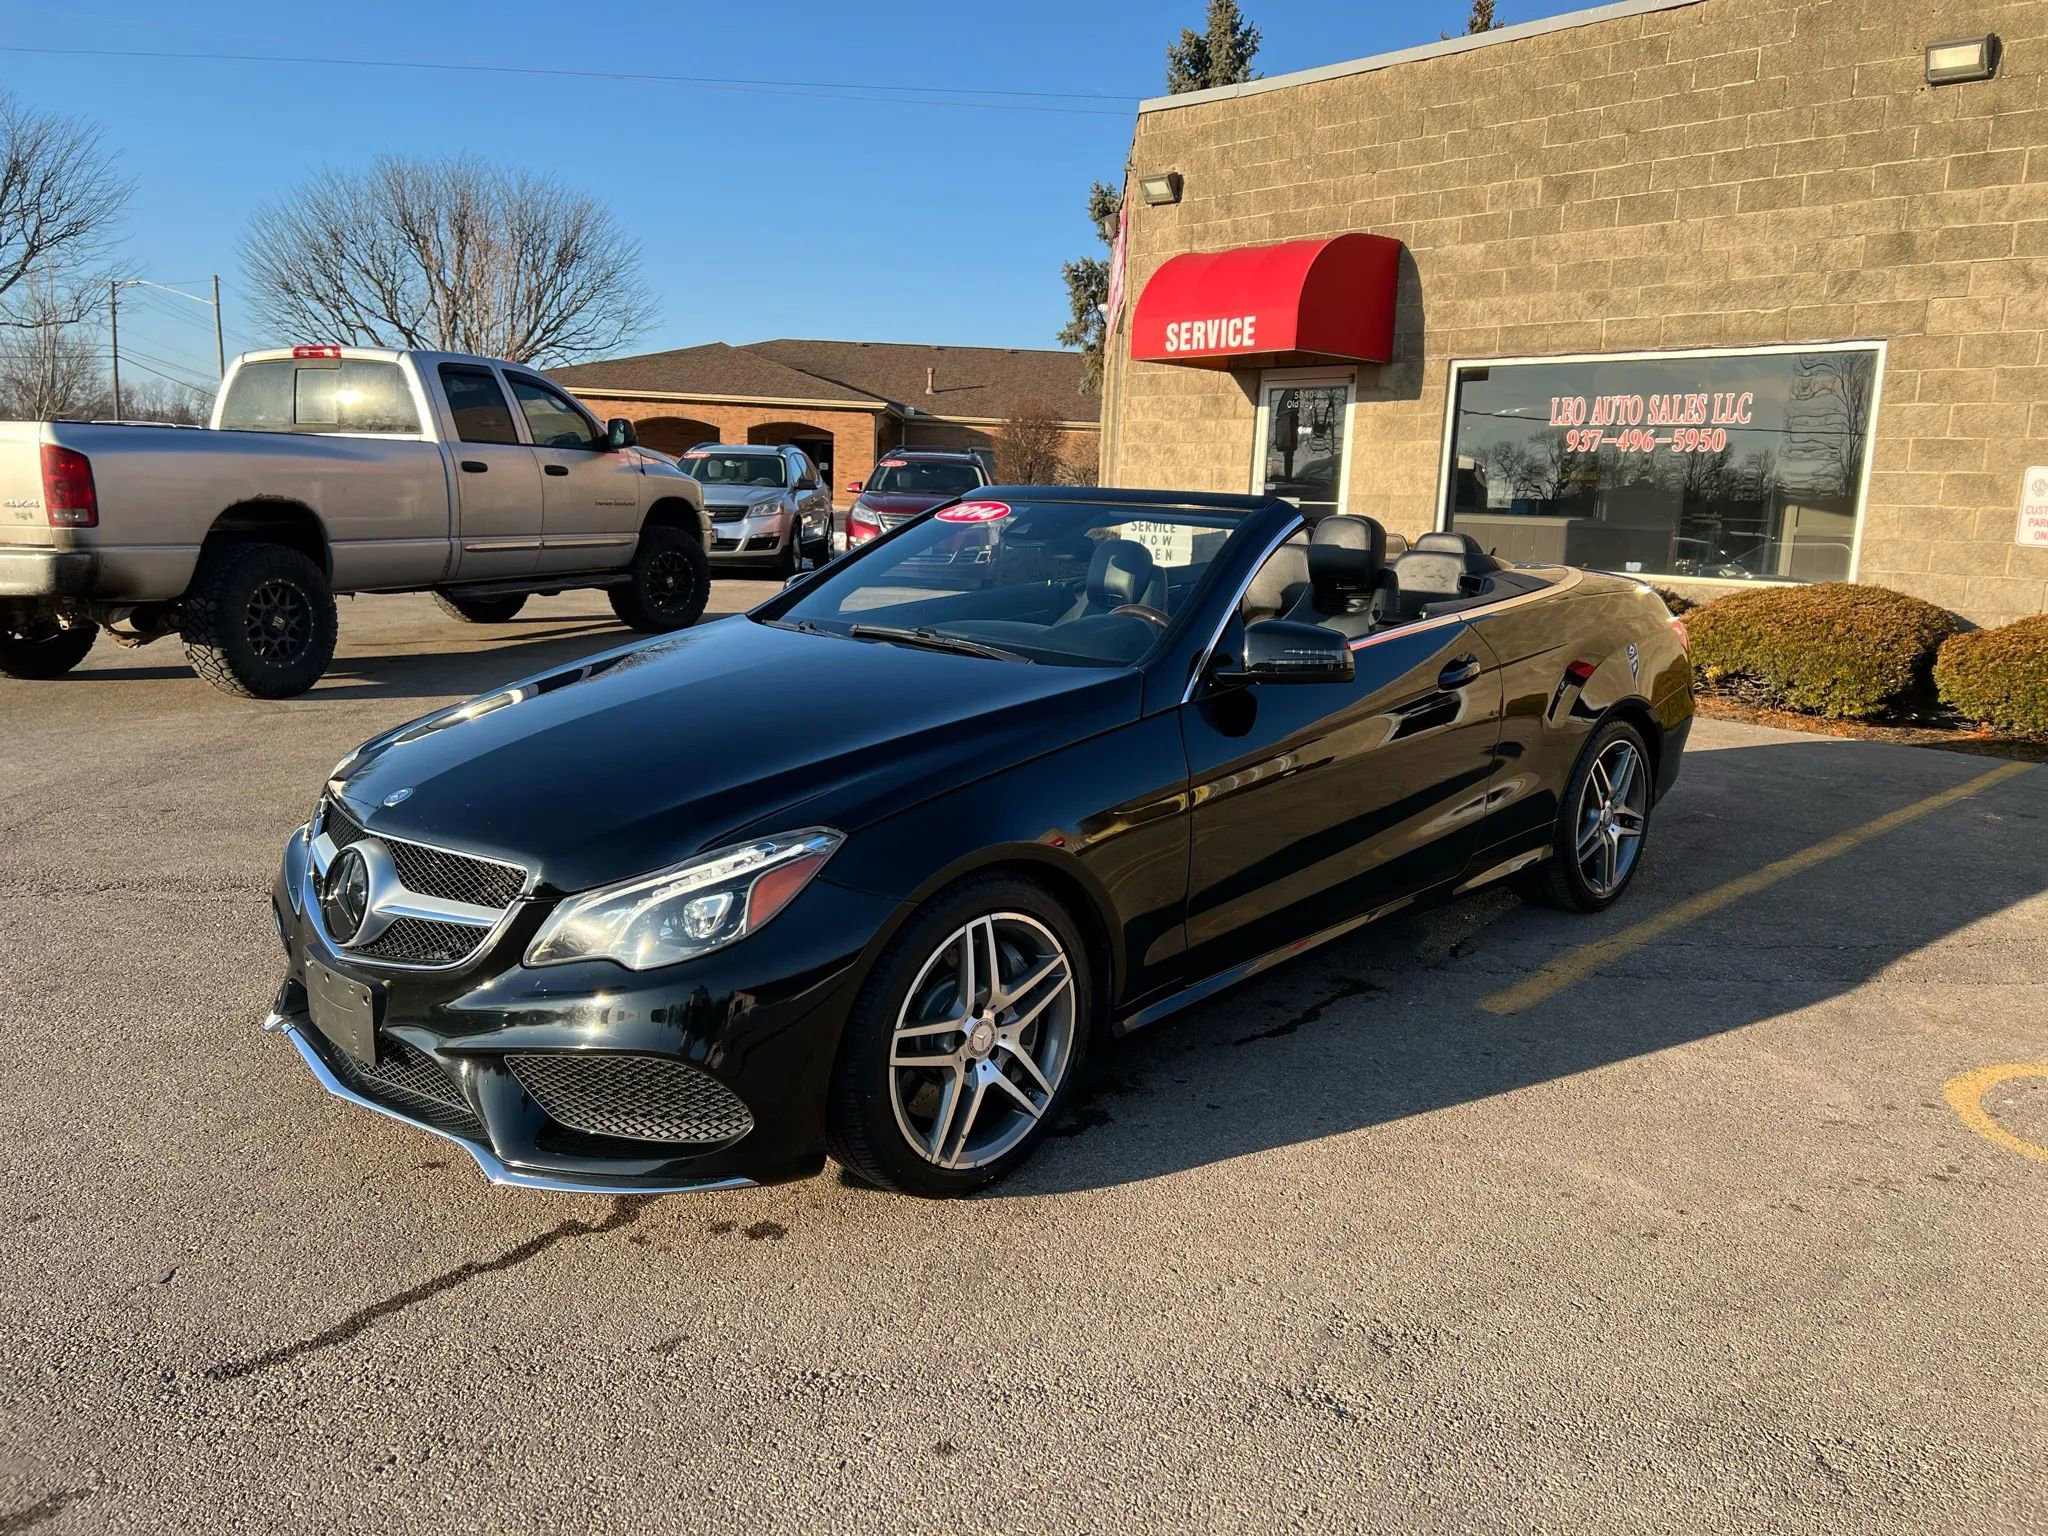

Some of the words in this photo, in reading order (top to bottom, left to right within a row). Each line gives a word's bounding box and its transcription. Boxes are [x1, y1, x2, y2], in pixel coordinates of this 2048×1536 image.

[1165, 316, 1256, 352] SERVICE
[1286, 400, 1299, 409] Old
[1550, 397, 1587, 426] LEO
[1589, 394, 1644, 426] AUTO
[1647, 393, 1709, 425] SALES
[1711, 391, 1754, 424] LLC
[1566, 428, 1727, 453] 937-496-5950
[940, 505, 1006, 519] 2014
[1131, 521, 1176, 534] SERVICE
[2027, 517, 2048, 528] PAR
[1139, 534, 1172, 546] NOW
[1155, 548, 1173, 561] EN
